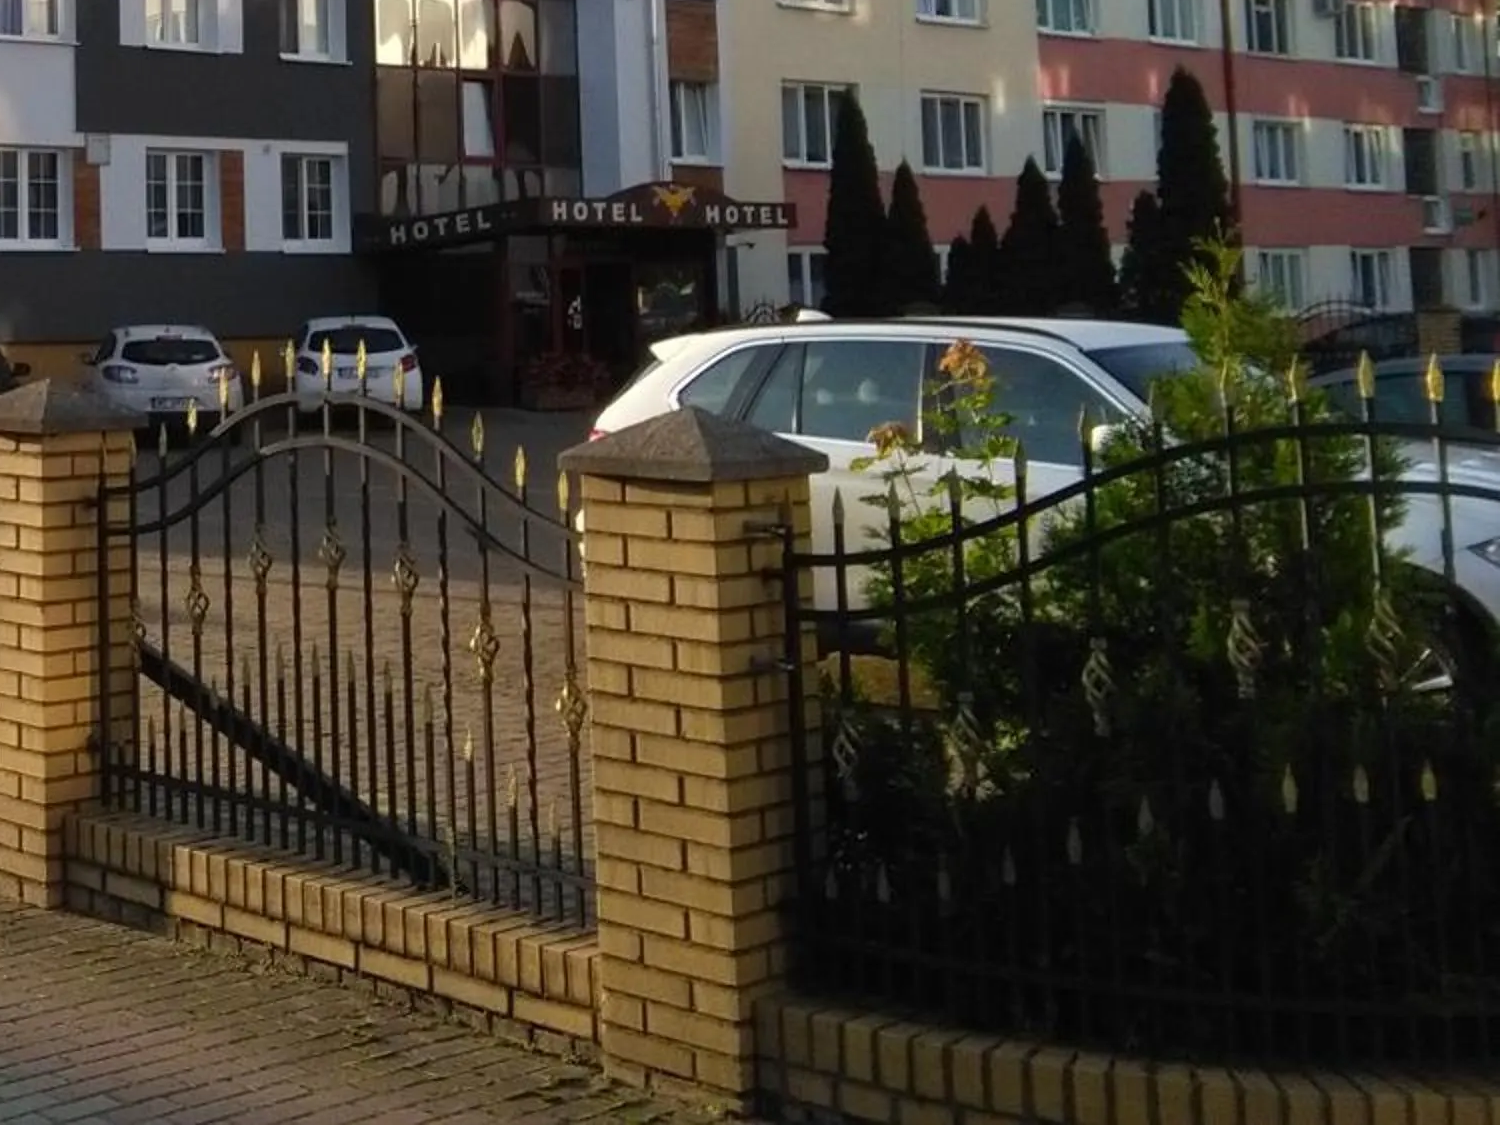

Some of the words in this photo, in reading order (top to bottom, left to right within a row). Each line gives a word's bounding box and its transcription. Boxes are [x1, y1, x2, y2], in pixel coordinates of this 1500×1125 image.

[553, 200, 644, 223] HOTEL
[704, 204, 790, 226] HOTEL
[389, 208, 494, 246] HOTEL
